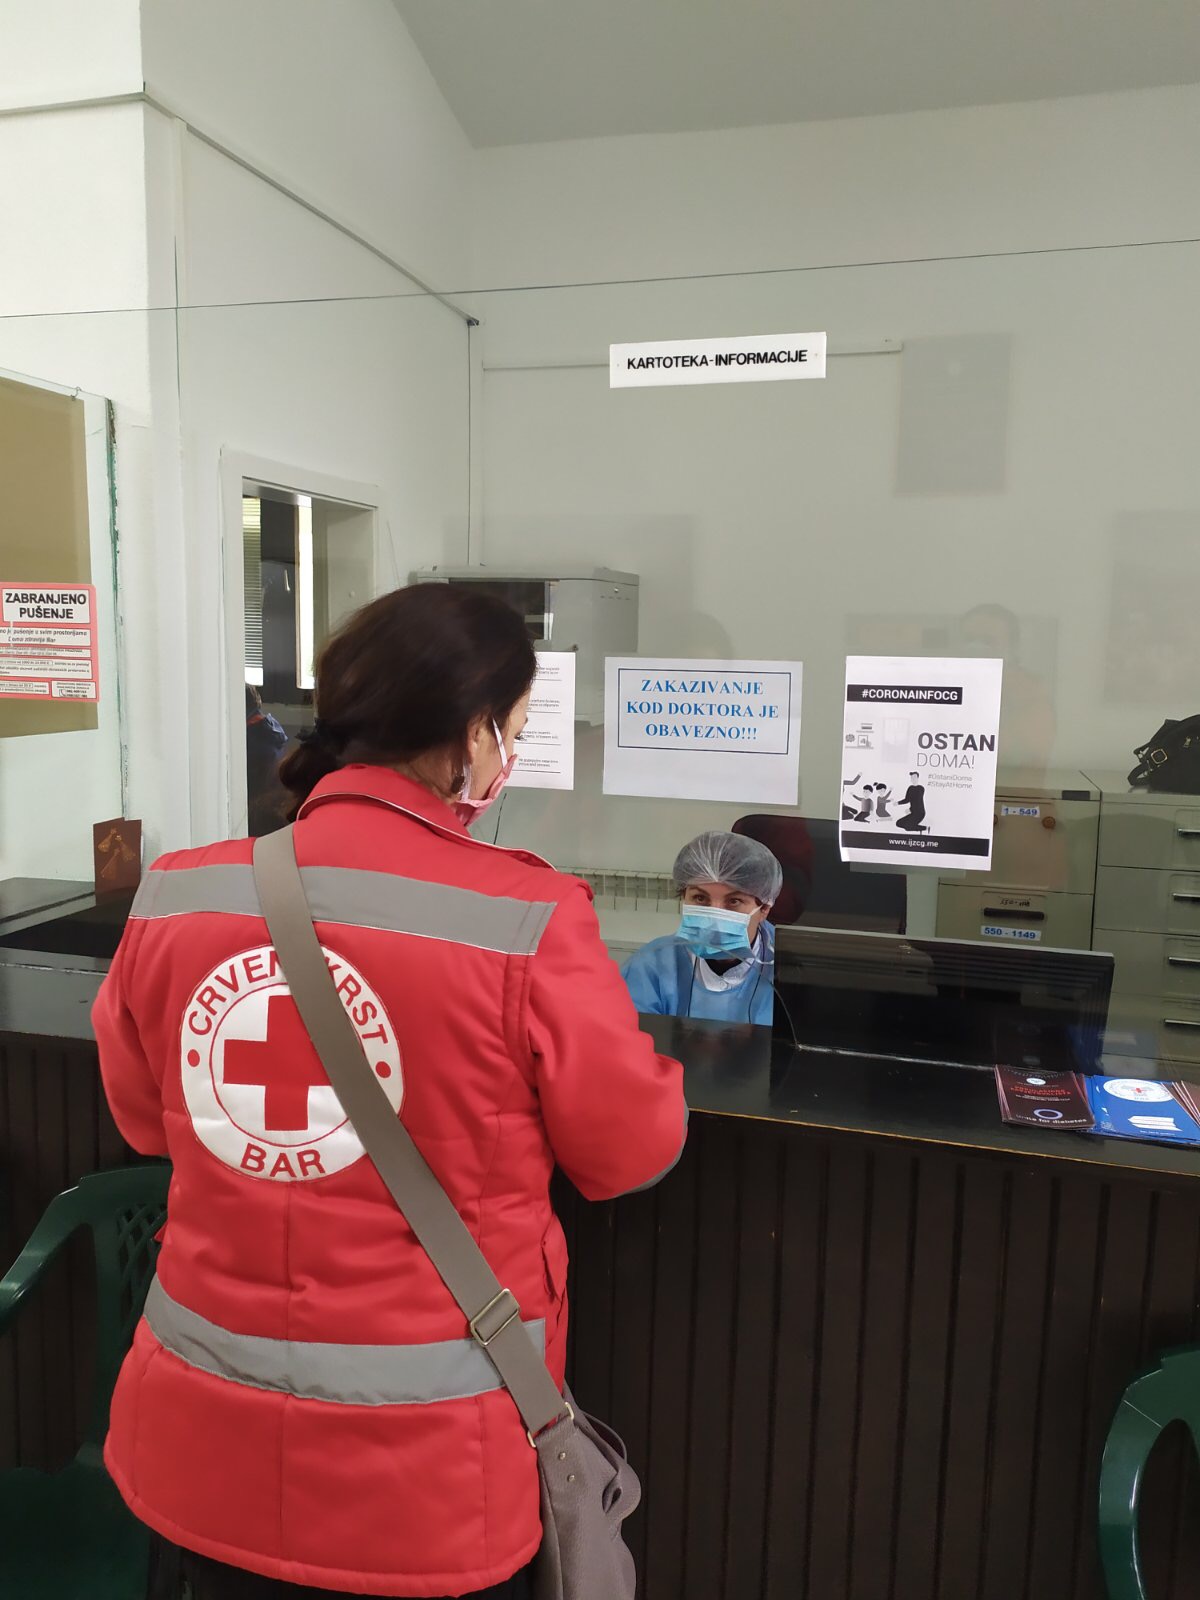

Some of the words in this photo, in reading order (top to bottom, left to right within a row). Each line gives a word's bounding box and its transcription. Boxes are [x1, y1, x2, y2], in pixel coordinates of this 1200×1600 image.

[627, 349, 808, 370] KARTOTEKA-INFORMACIJE
[5, 592, 87, 605] ZABRANJENO
[19, 605, 74, 619] PUŠENJE
[641, 679, 764, 695] ZAKAZIVANJE
[861, 688, 959, 701] #CORONAINFOCG
[626, 701, 663, 715] KOD
[668, 702, 754, 718] DOKTORA
[758, 705, 779, 719] JE
[645, 723, 758, 740] OBAVEZNO!!!
[917, 732, 996, 752] OSTAN
[916, 752, 975, 769] DOMA!
[927, 780, 973, 789] #StayAtHome
[1003, 807, 1009, 815] 1
[1019, 807, 1038, 816] 549
[888, 838, 939, 848] www.ijzcg.me
[984, 927, 1003, 936] 550
[1012, 930, 1036, 939] 1149
[239, 1142, 326, 1178] BAR
